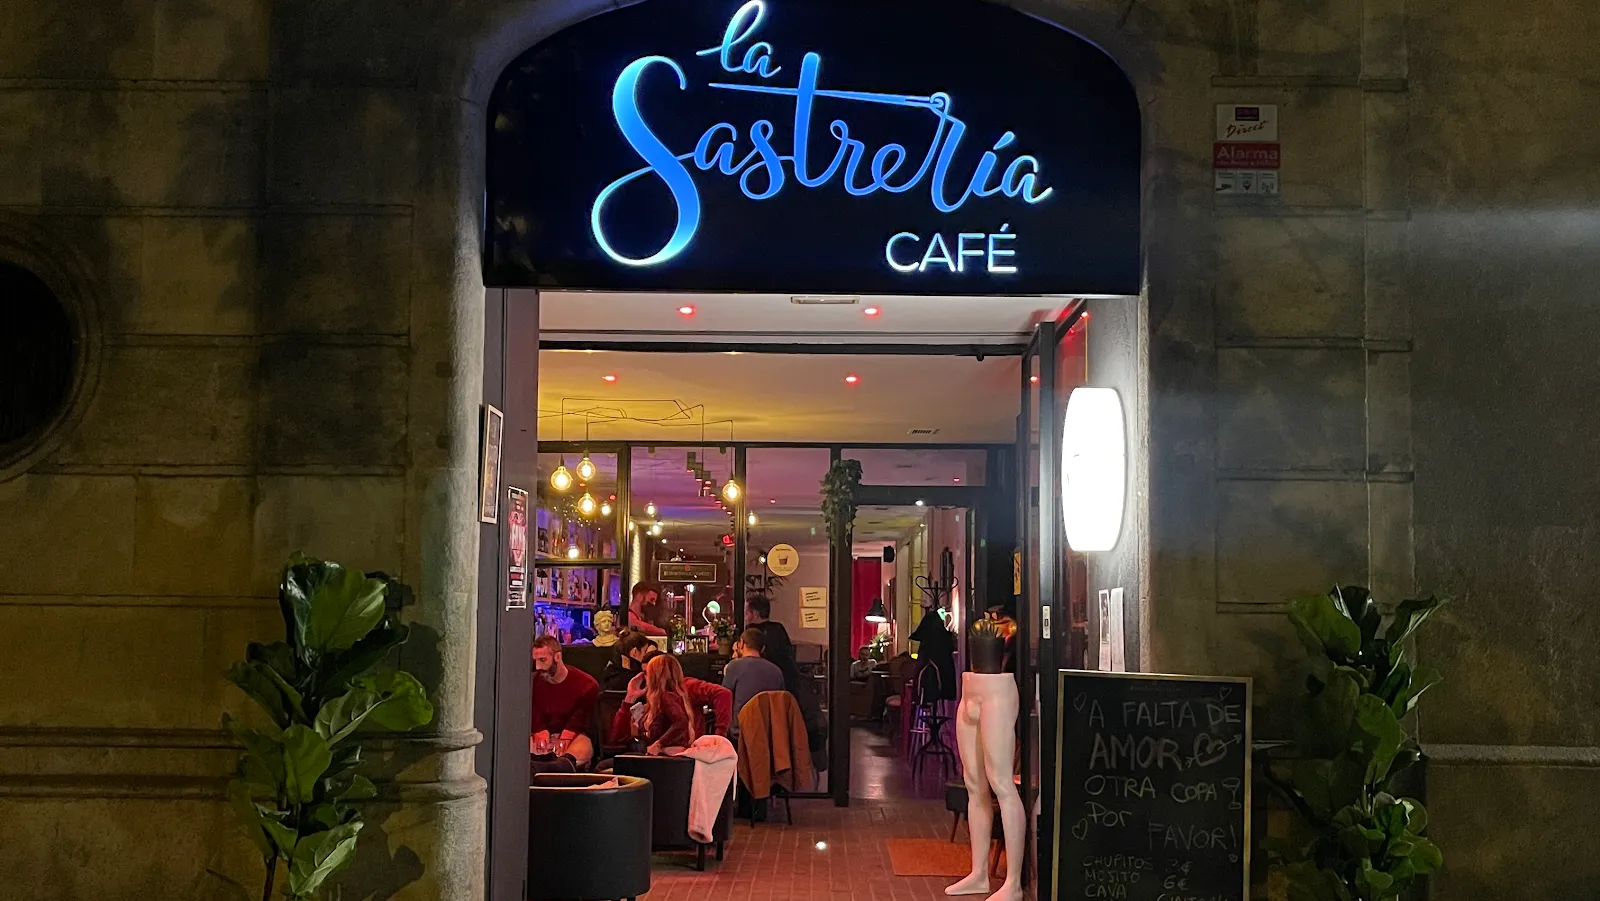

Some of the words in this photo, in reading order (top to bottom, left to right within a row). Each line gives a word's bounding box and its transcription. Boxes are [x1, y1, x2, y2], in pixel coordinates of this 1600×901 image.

[696, 0, 782, 78] la
[1226, 120, 1270, 138] Direct
[591, 51, 1054, 267] Sastrería
[1217, 145, 1278, 160] Alarma
[884, 223, 1019, 274] CAFÉ
[1088, 699, 1105, 728] A
[1122, 700, 1197, 729] FALTA
[1207, 704, 1241, 726] DE
[1088, 732, 1183, 771] AMOR
[1084, 774, 1156, 799] OTRA
[1170, 782, 1218, 803] COPA
[1084, 883, 1127, 899] CAVA
